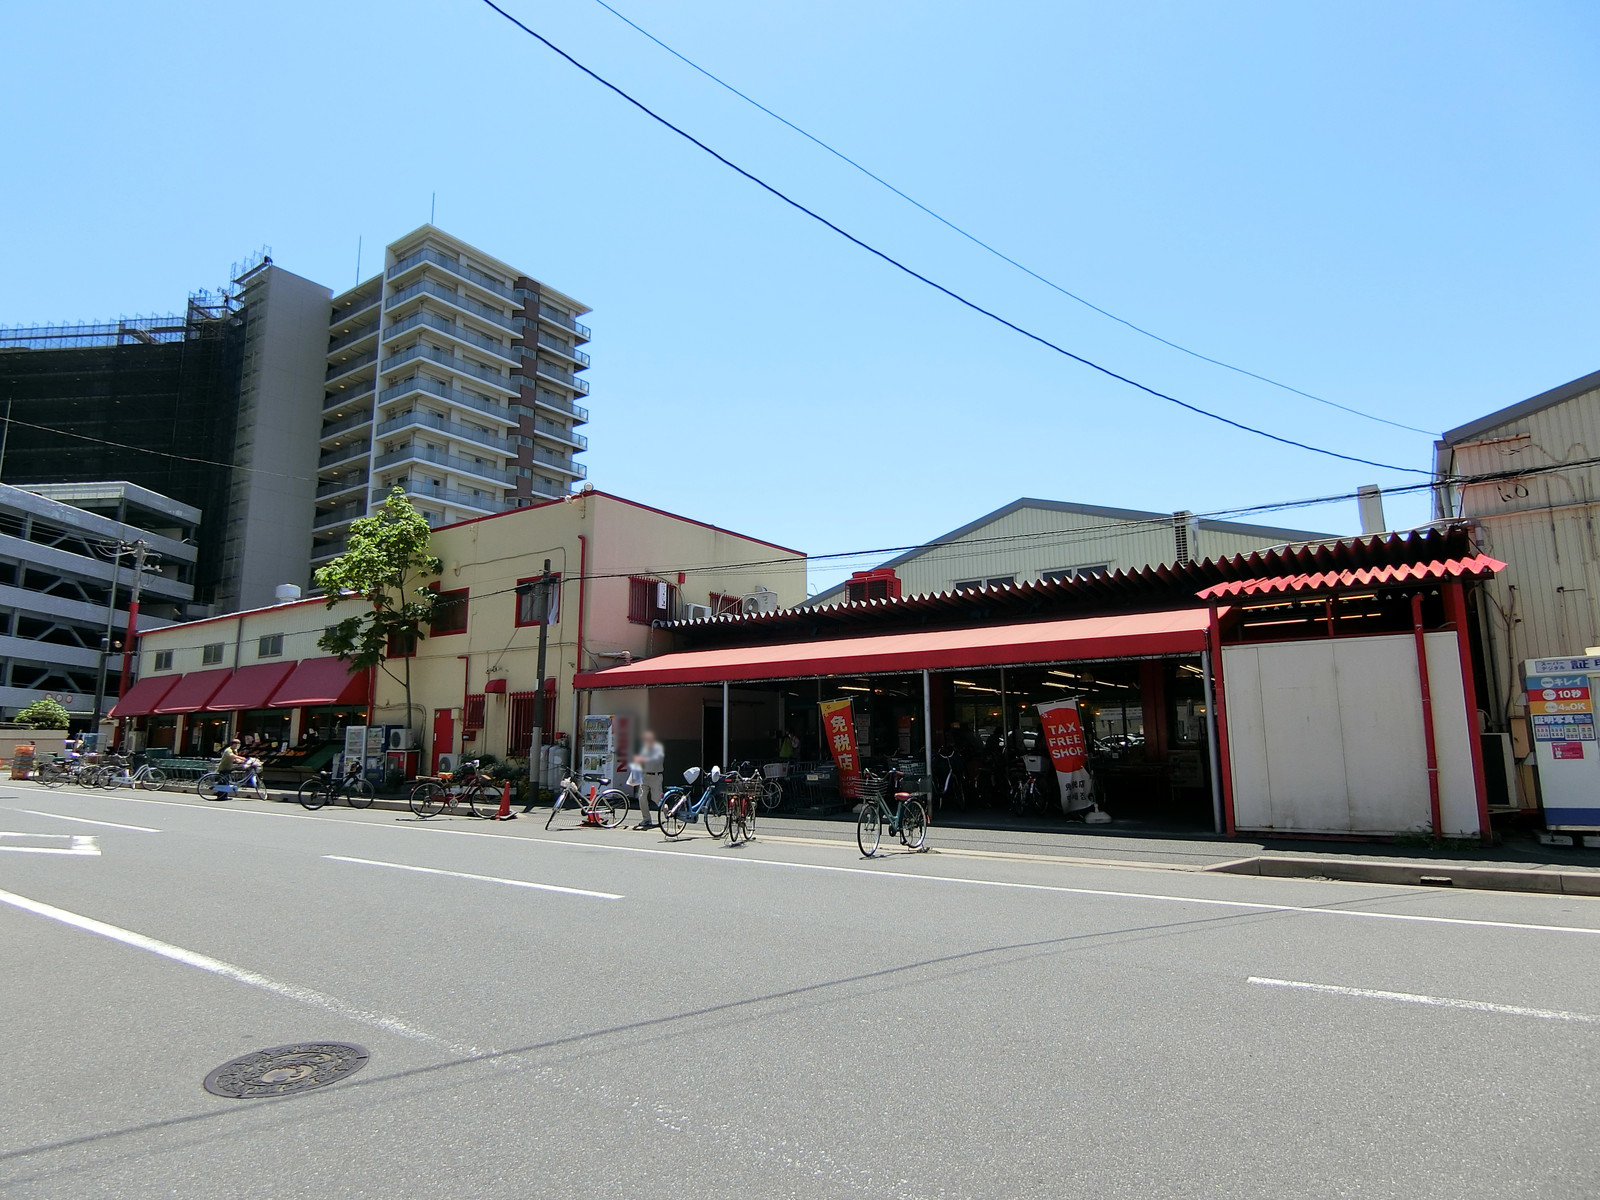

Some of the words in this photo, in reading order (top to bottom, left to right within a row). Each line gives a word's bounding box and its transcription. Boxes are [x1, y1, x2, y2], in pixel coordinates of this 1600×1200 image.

[1554, 677, 1581, 686] キレイ
[1558, 689, 1581, 698] 10秒
[1048, 722, 1077, 735] TAX
[830, 715, 853, 771] 免税店
[1049, 734, 1081, 747] FREE
[1052, 746, 1083, 759] SHOP
